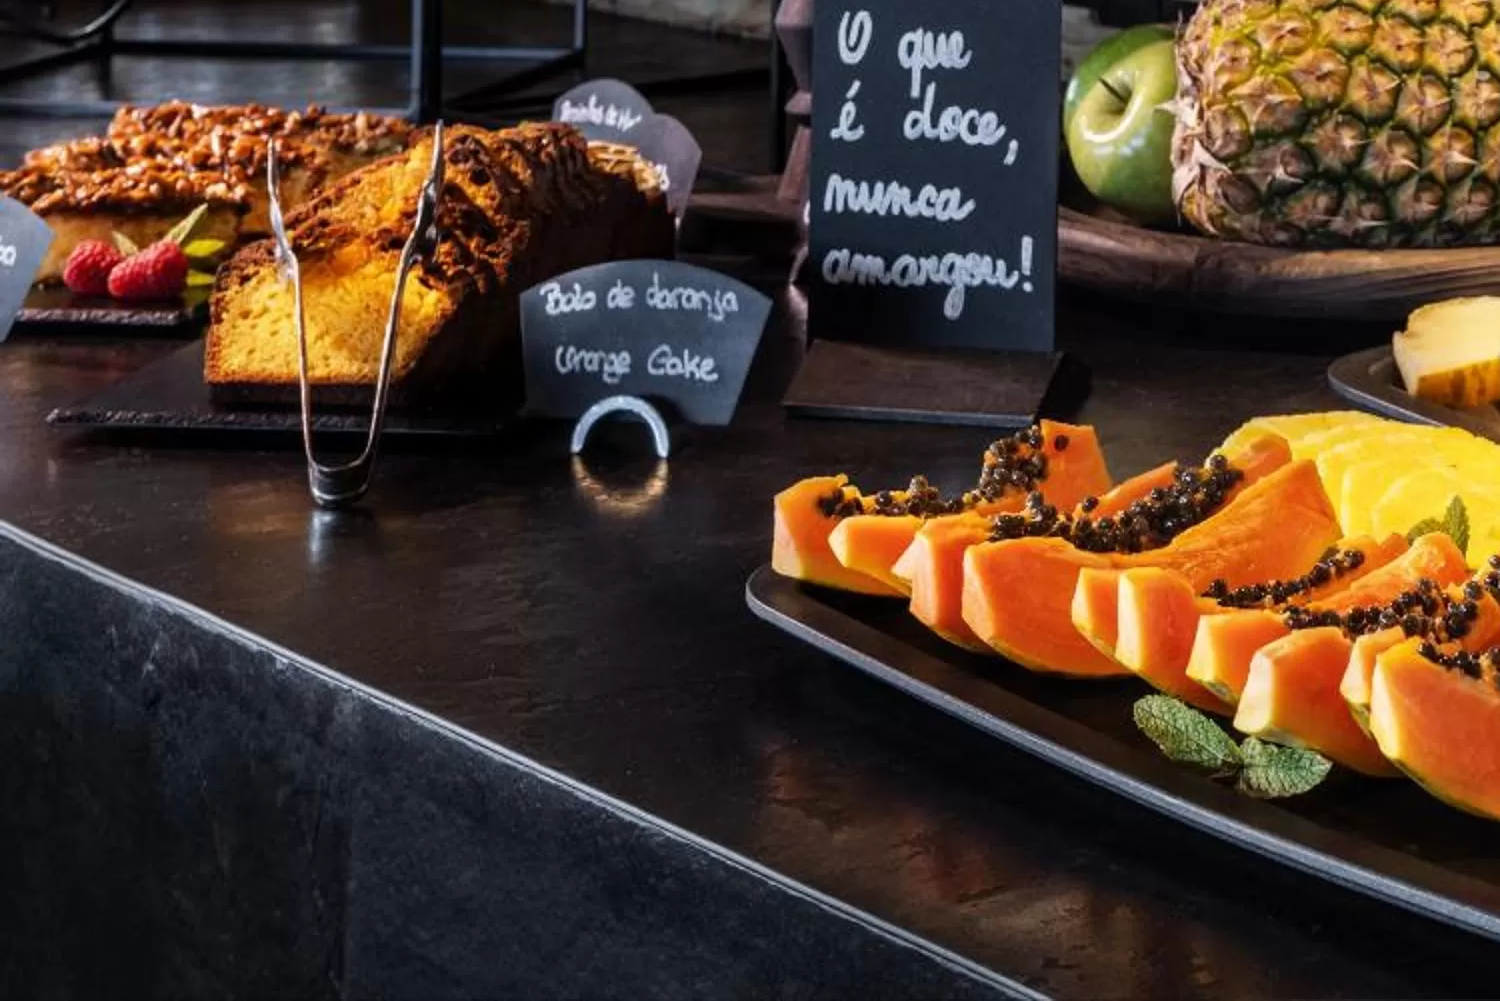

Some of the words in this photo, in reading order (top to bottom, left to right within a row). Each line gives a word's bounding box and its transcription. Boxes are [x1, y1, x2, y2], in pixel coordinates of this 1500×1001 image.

[837, 10, 873, 65] O
[897, 27, 972, 99] que
[829, 80, 865, 141] é
[903, 82, 1019, 165] doce,
[823, 173, 975, 222] nunca
[539, 281, 597, 316] Bolo
[607, 278, 635, 309] de
[822, 235, 1033, 317] amargou!
[647, 344, 719, 382] Cake
